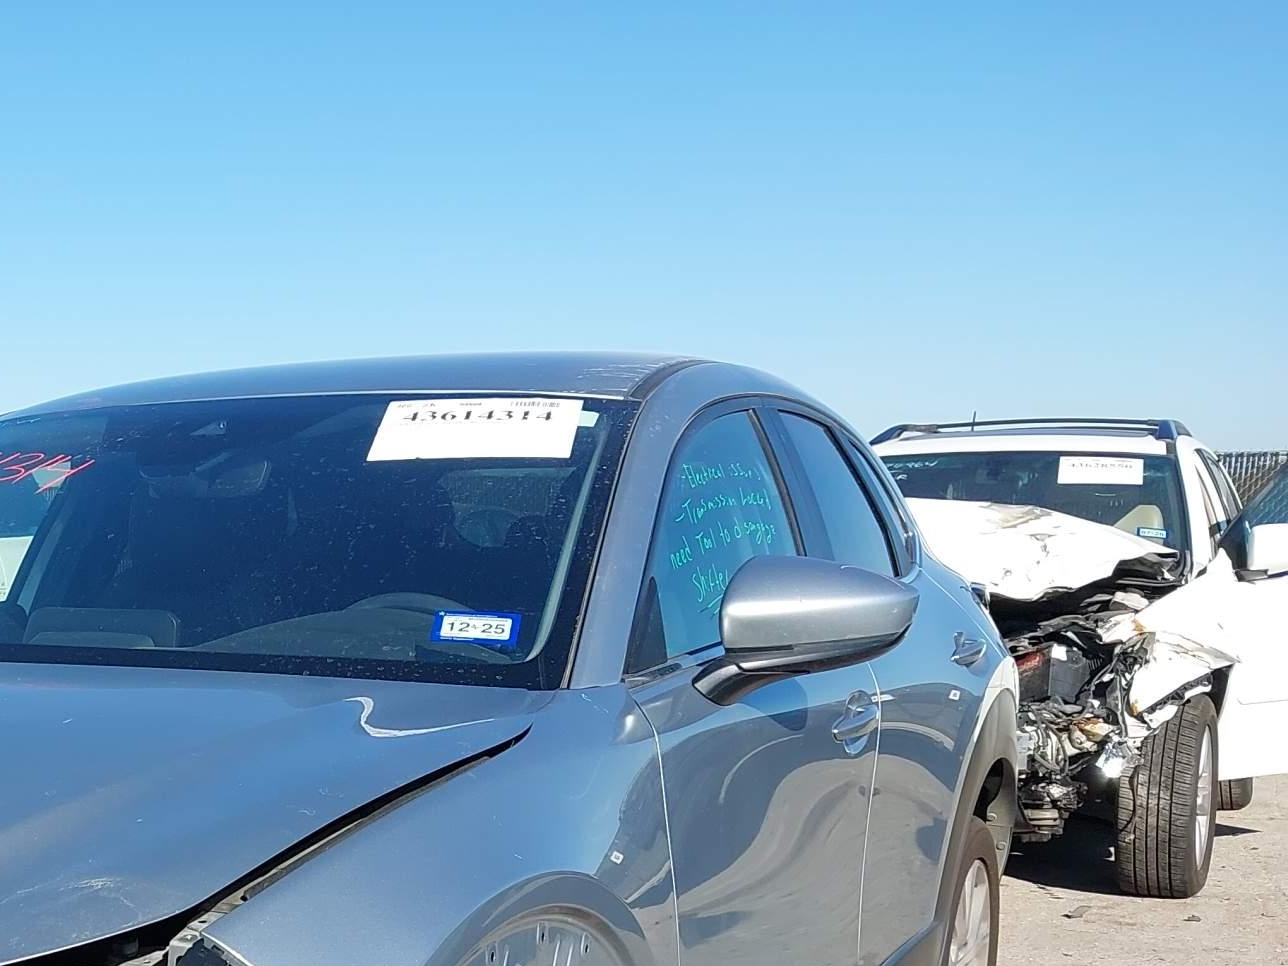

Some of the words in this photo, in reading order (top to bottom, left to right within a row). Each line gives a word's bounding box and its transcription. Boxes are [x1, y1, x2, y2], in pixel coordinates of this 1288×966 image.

[402, 410, 553, 422] 43614314
[670, 535, 694, 569] need
[717, 520, 731, 547] to
